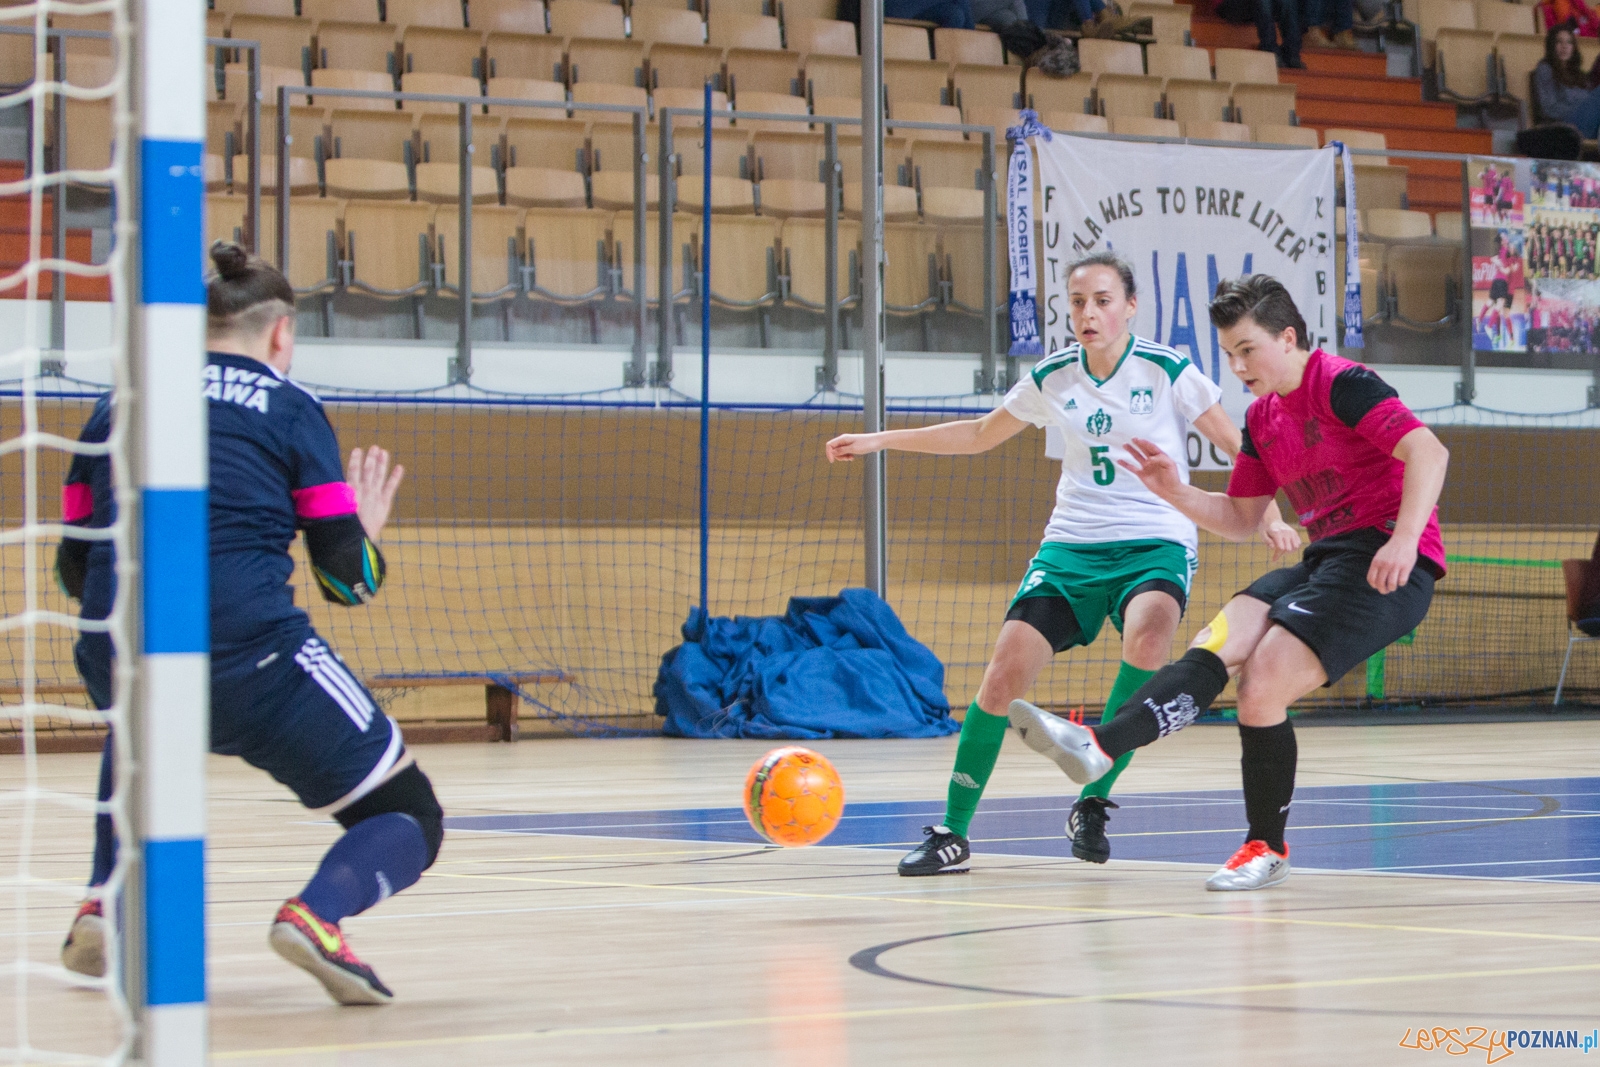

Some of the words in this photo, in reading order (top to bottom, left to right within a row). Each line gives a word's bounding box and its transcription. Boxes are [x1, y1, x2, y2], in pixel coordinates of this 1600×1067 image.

[1017, 205, 1030, 279] KOBIET
[1098, 188, 1143, 224] WAS
[1156, 186, 1186, 214] TO
[1195, 186, 1245, 218] PARE
[1248, 200, 1306, 263] LITER
[201, 381, 269, 414] AWA
[1088, 445, 1116, 487] 5
[1023, 569, 1047, 593] 5
